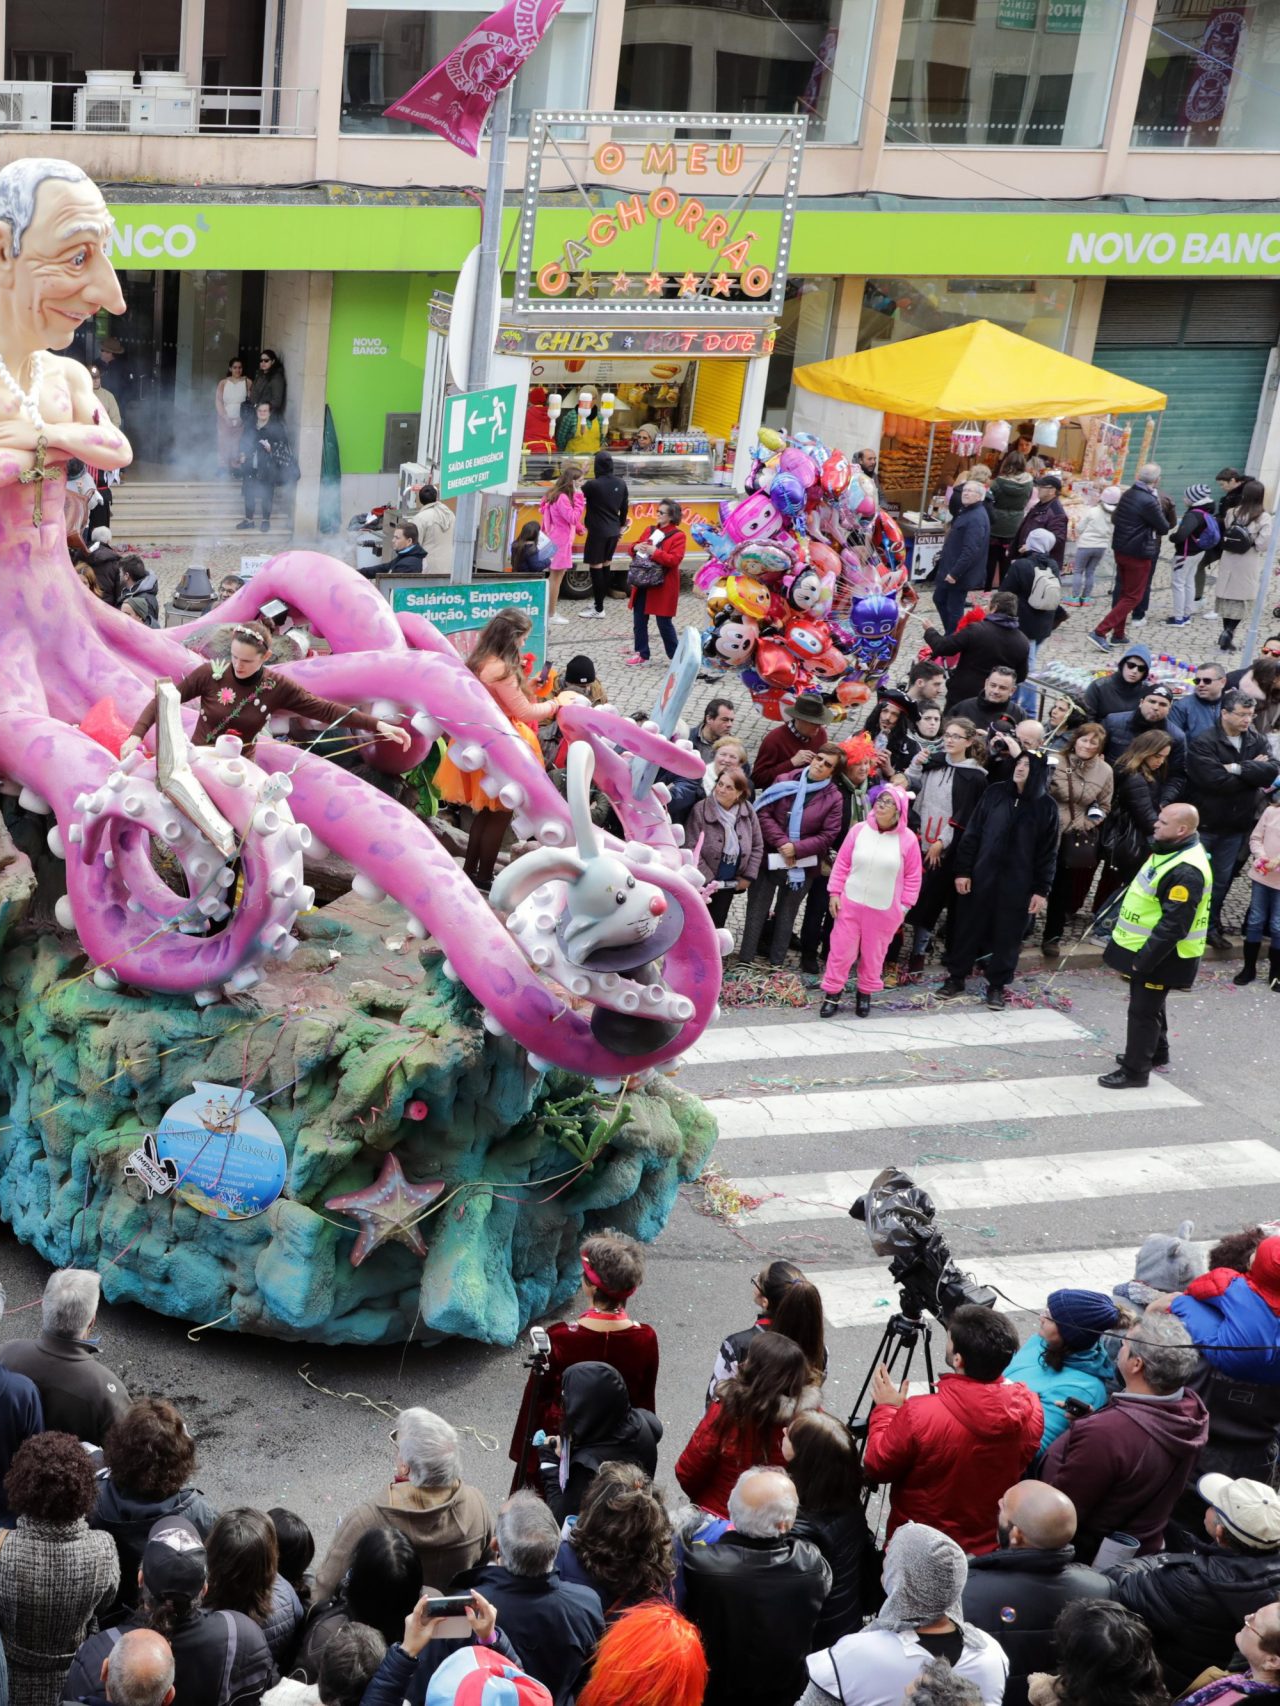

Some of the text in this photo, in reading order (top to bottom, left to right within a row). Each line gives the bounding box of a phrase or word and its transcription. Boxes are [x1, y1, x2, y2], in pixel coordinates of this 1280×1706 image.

[595, 142, 744, 176] O MEU
[104, 224, 197, 258] NCO
[536, 187, 772, 297] CACHORRÃO
[1066, 232, 1177, 264] NOVO
[352, 346, 387, 355] BANCO
[353, 337, 382, 346] NOVO
[534, 331, 614, 351] CHIPS
[703, 332, 756, 351] DOG
[448, 451, 504, 473] SAÍDA DE EMERGÊNCIA
[448, 471, 490, 490] EMERGENCY EXIT
[406, 588, 533, 607] Salários, Emprego,
[422, 607, 467, 624] dução,
[135, 1154, 167, 1186] IMPACTO
